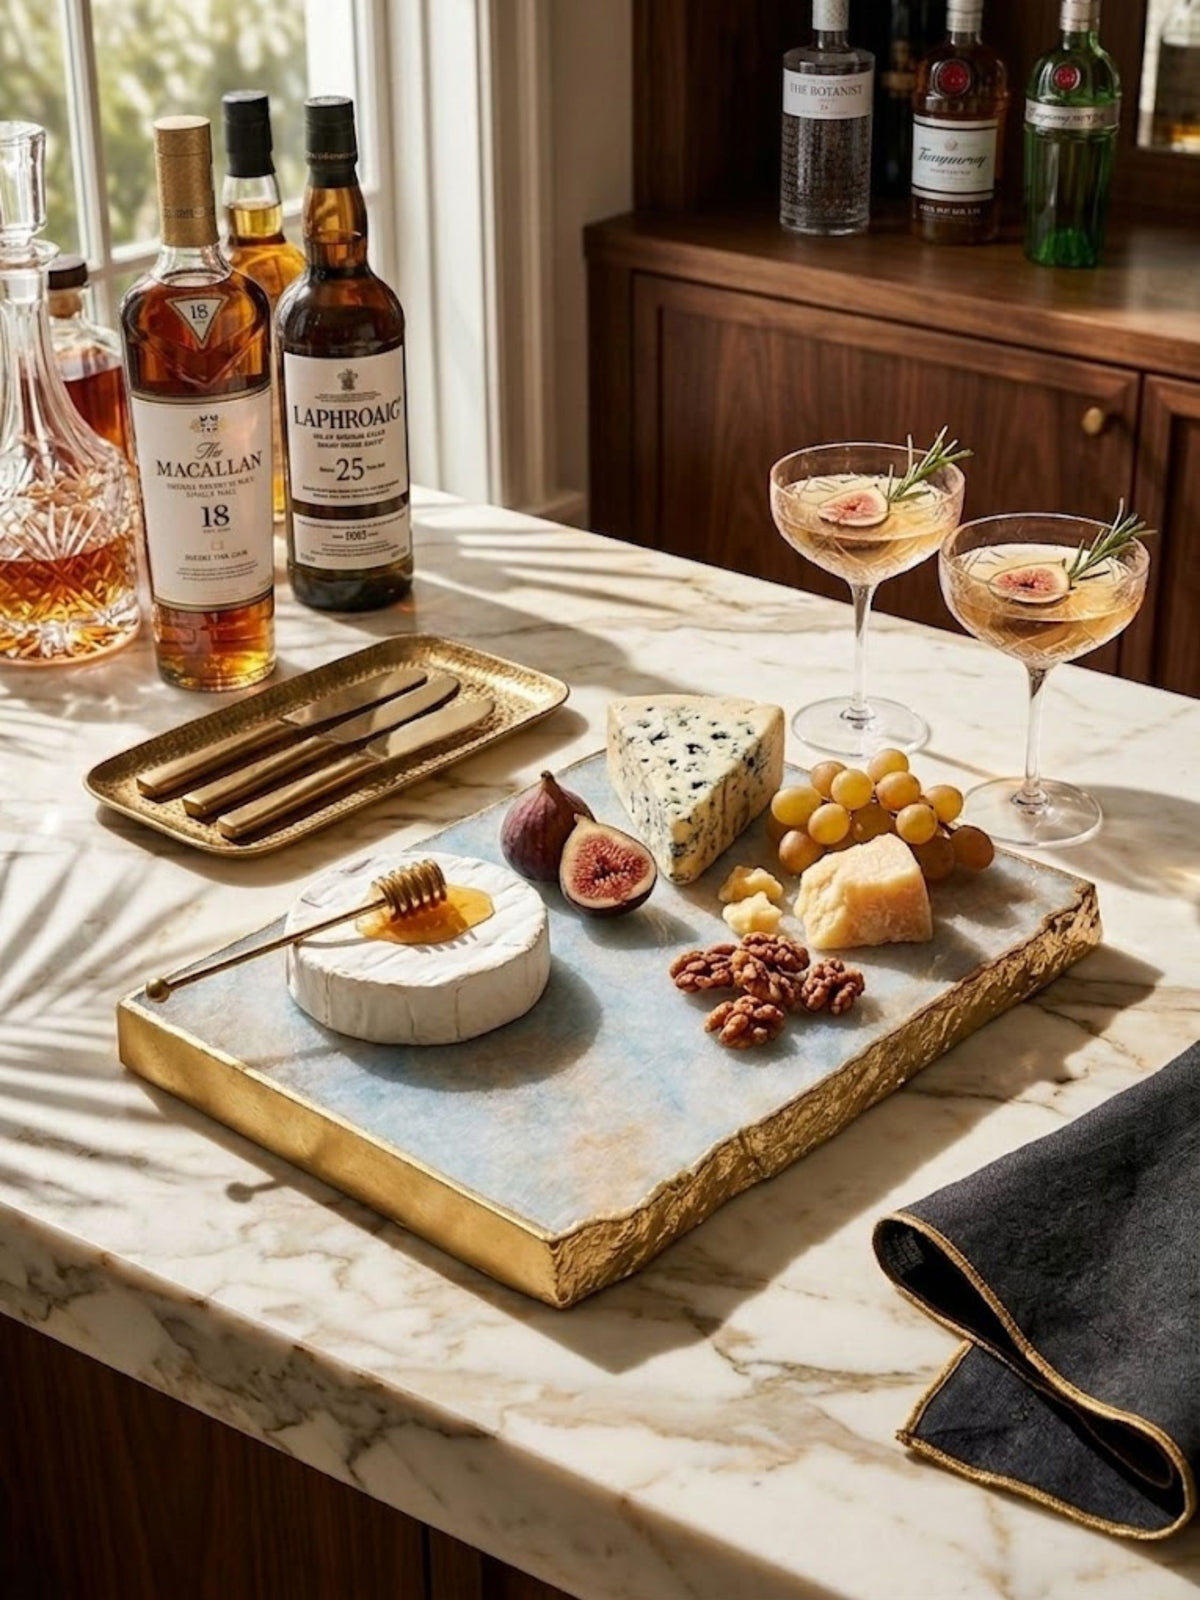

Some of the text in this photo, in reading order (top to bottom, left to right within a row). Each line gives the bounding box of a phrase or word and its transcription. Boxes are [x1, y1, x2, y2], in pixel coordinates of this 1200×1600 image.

[811, 84, 863, 97] BOTANIST
[190, 303, 208, 319] 18
[293, 395, 402, 429] LAPHROAIG
[155, 450, 262, 478] MACALLAN
[336, 457, 365, 481] 25
[200, 504, 230, 528] 18
